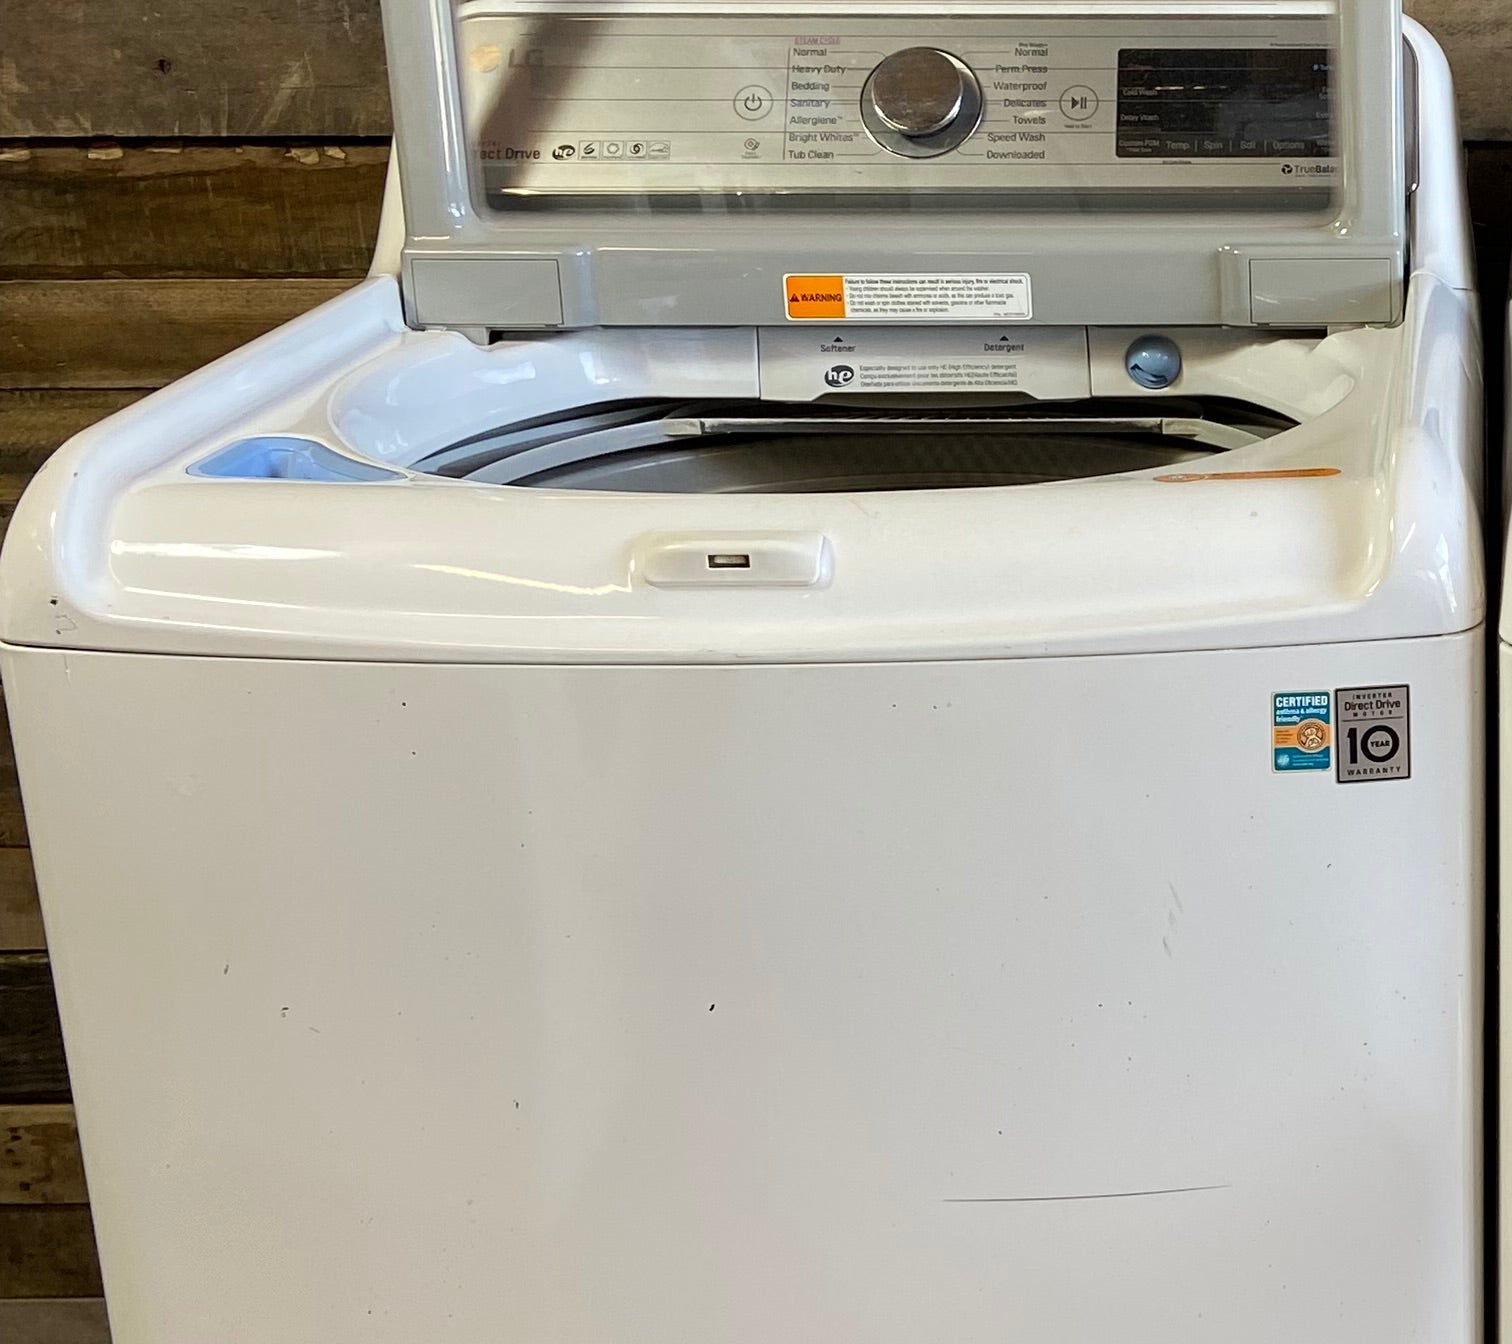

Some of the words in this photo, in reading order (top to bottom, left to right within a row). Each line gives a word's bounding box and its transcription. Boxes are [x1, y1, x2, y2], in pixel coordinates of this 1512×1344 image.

[793, 48, 827, 56] Normal
[1015, 48, 1048, 56] Normal
[792, 65, 822, 74] Heavy
[824, 65, 847, 74] Duty
[792, 82, 830, 91] Bedding
[993, 82, 1047, 92] Waterproof
[791, 99, 830, 108] Sanitary
[1004, 99, 1047, 107] Delicates
[1013, 116, 1046, 124] Towels
[789, 133, 819, 143] Bright
[987, 133, 1016, 143] Speed
[1018, 133, 1045, 143] Wash
[505, 148, 541, 160] Drive
[788, 150, 806, 159] Tub
[808, 150, 834, 159] Clean
[986, 150, 1045, 159] Downloaded
[801, 293, 842, 303] WARNING
[820, 343, 857, 353] Softener
[984, 343, 1024, 353] Detergent
[826, 365, 853, 386] he
[1352, 692, 1392, 700] INVERTER
[1276, 695, 1328, 708] CERTIFIED
[1344, 700, 1374, 711] Direct
[1376, 699, 1401, 710] Drive
[1306, 707, 1327, 716] allergy
[1347, 724, 1400, 764] 10
[1347, 767, 1401, 776] WARRANTY
